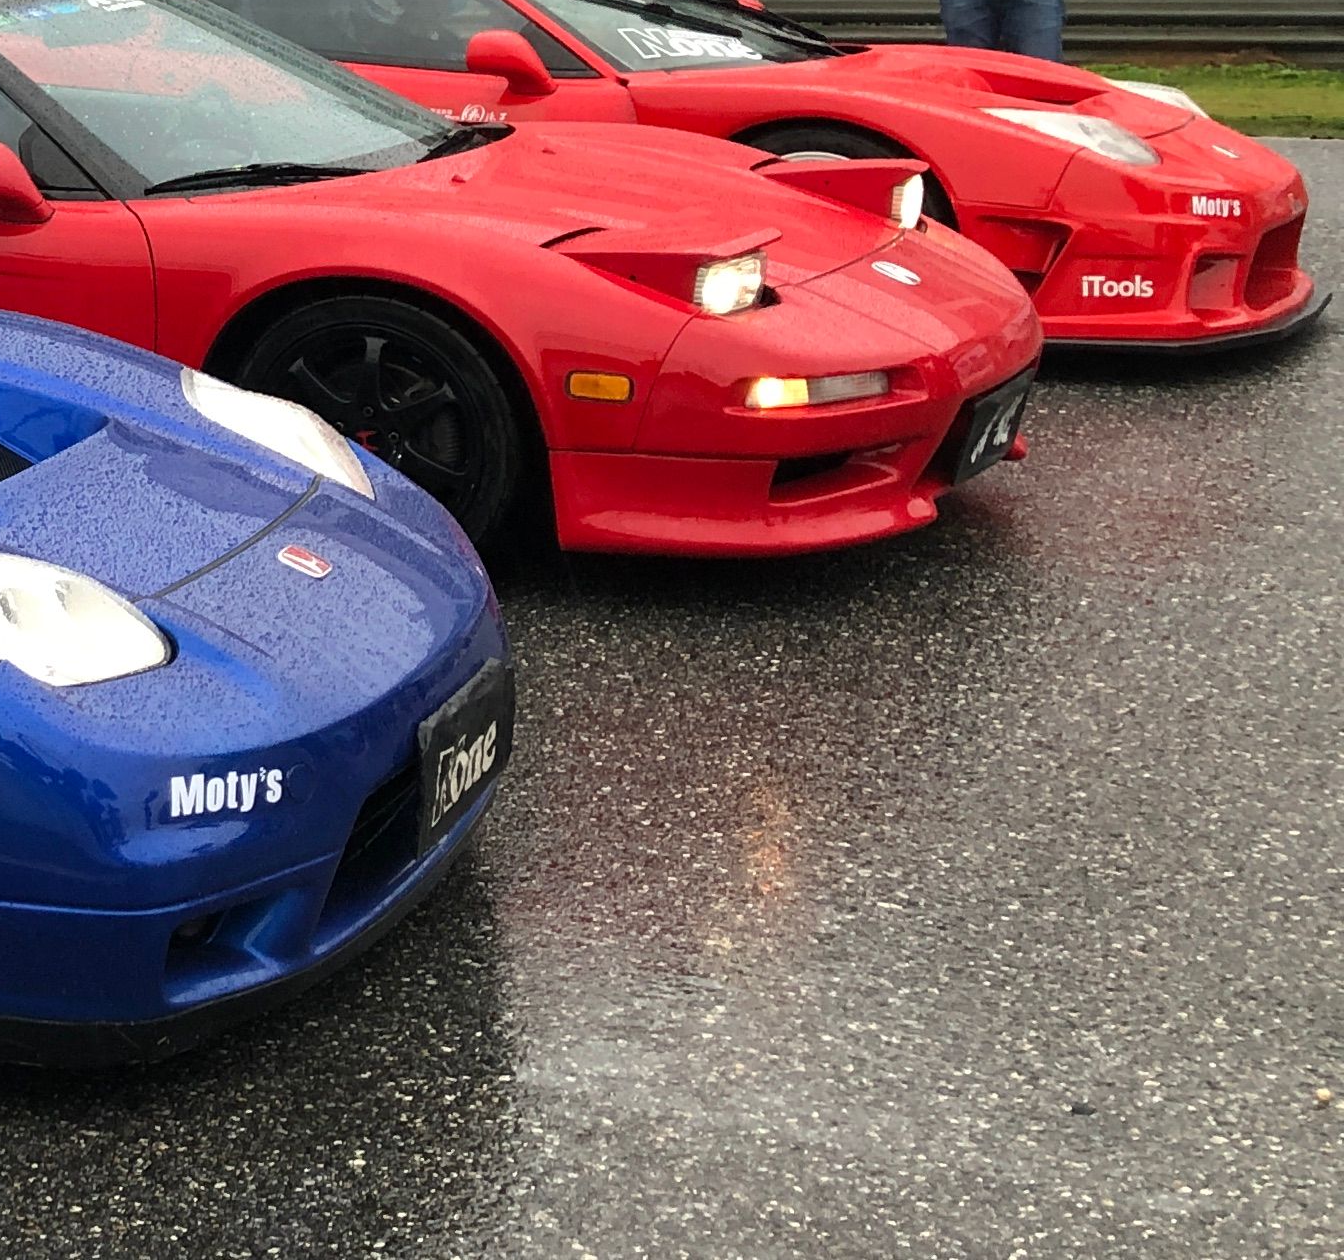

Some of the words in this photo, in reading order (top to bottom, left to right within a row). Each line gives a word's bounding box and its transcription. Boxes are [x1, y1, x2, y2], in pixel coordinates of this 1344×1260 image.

[1192, 195, 1242, 217] Moty's
[1081, 275, 1154, 298] iTools
[170, 766, 283, 818] Moty's
